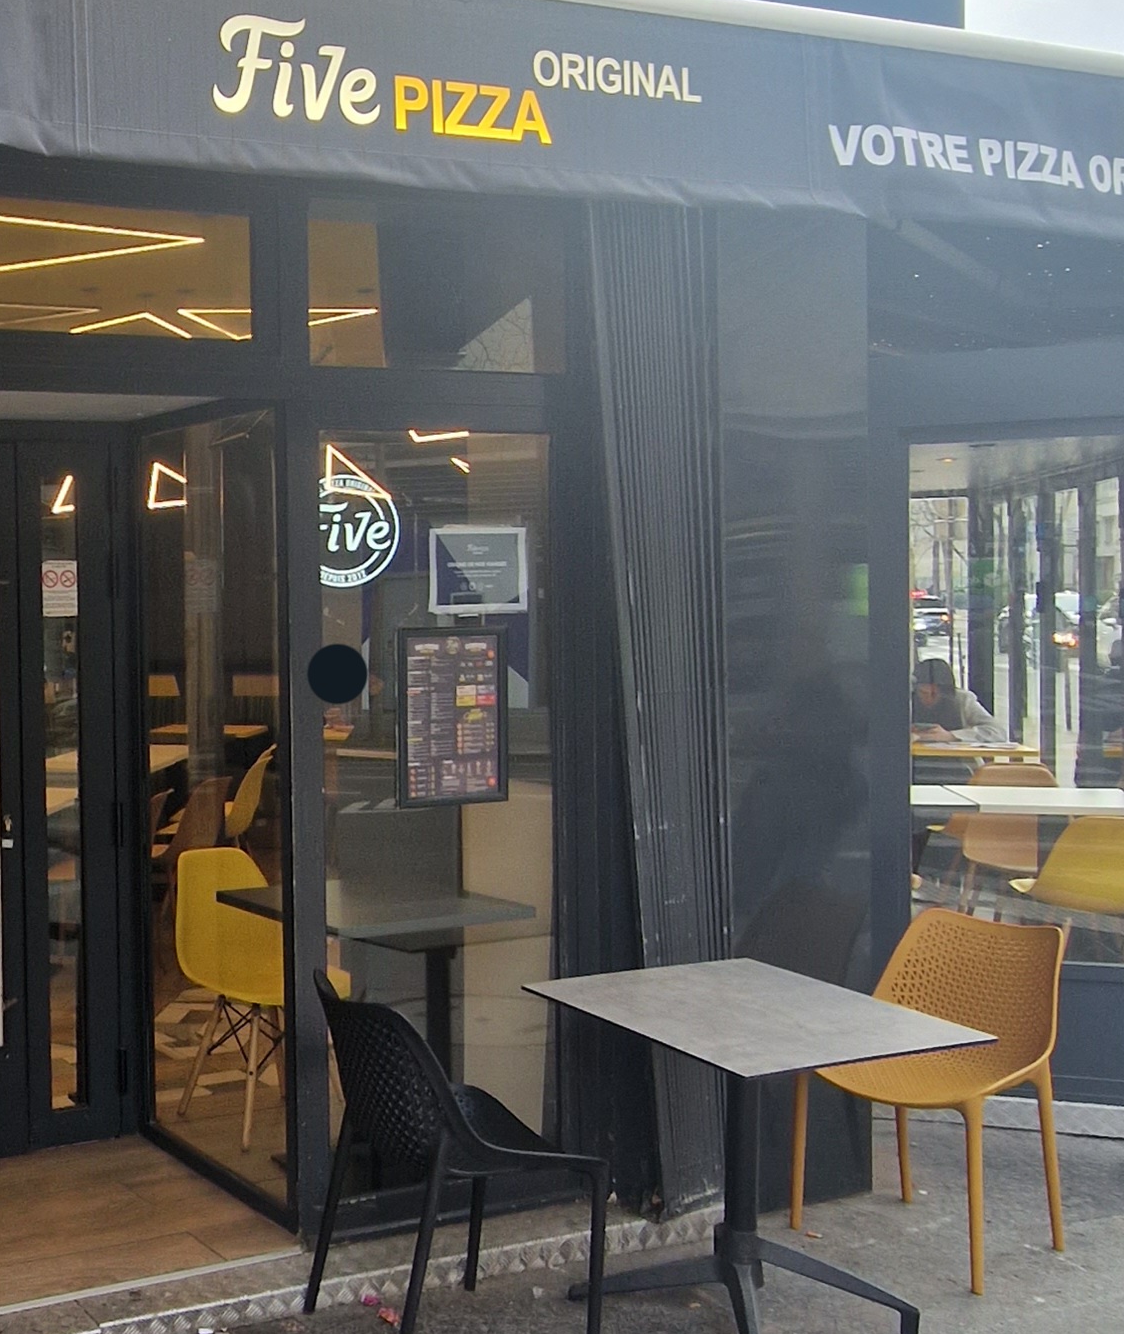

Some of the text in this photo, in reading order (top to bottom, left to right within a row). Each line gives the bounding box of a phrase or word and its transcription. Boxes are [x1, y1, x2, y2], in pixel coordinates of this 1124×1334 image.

[212, 14, 703, 147] Five PIZZA ORIGINAL
[827, 123, 974, 174] VOTRE
[979, 138, 1085, 190] PIZZA
